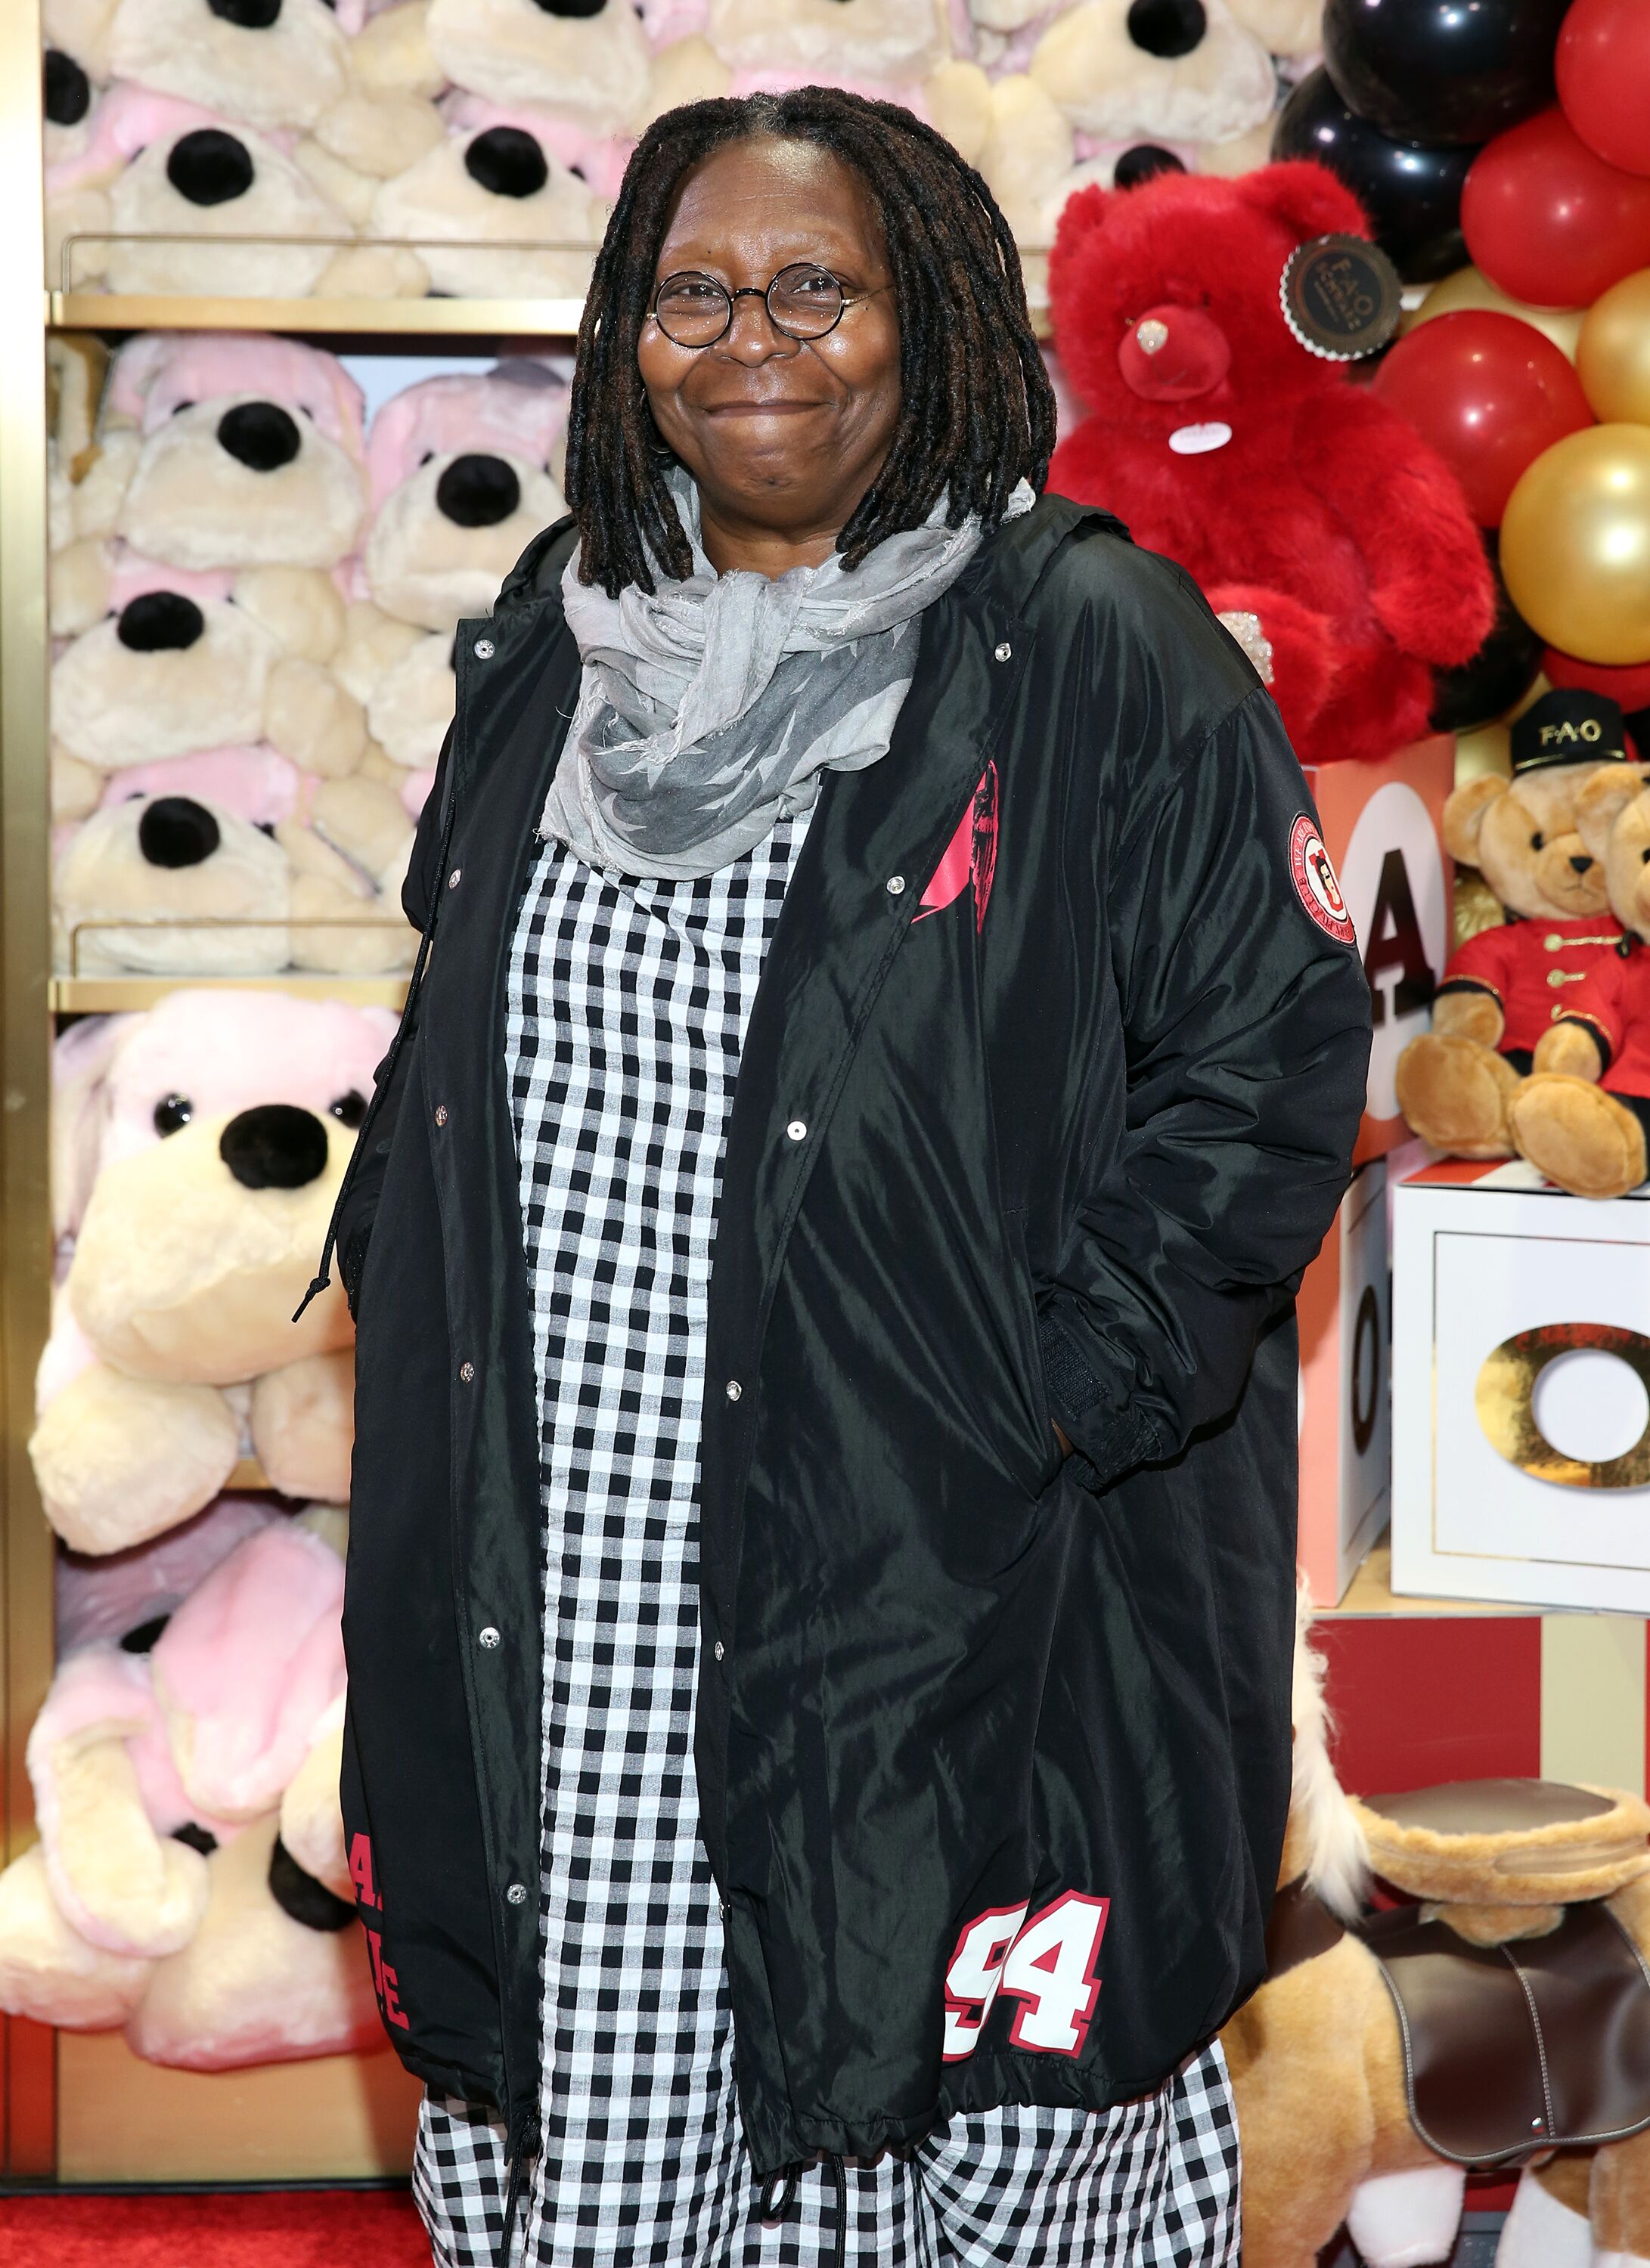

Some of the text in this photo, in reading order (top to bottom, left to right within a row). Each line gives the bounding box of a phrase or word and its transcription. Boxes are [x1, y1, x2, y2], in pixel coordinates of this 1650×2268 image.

[1299, 877, 1320, 913] CLUB
[1364, 848, 1434, 1029] A
[1475, 1322, 1650, 1490] O
[943, 1889, 1111, 2062] 94
